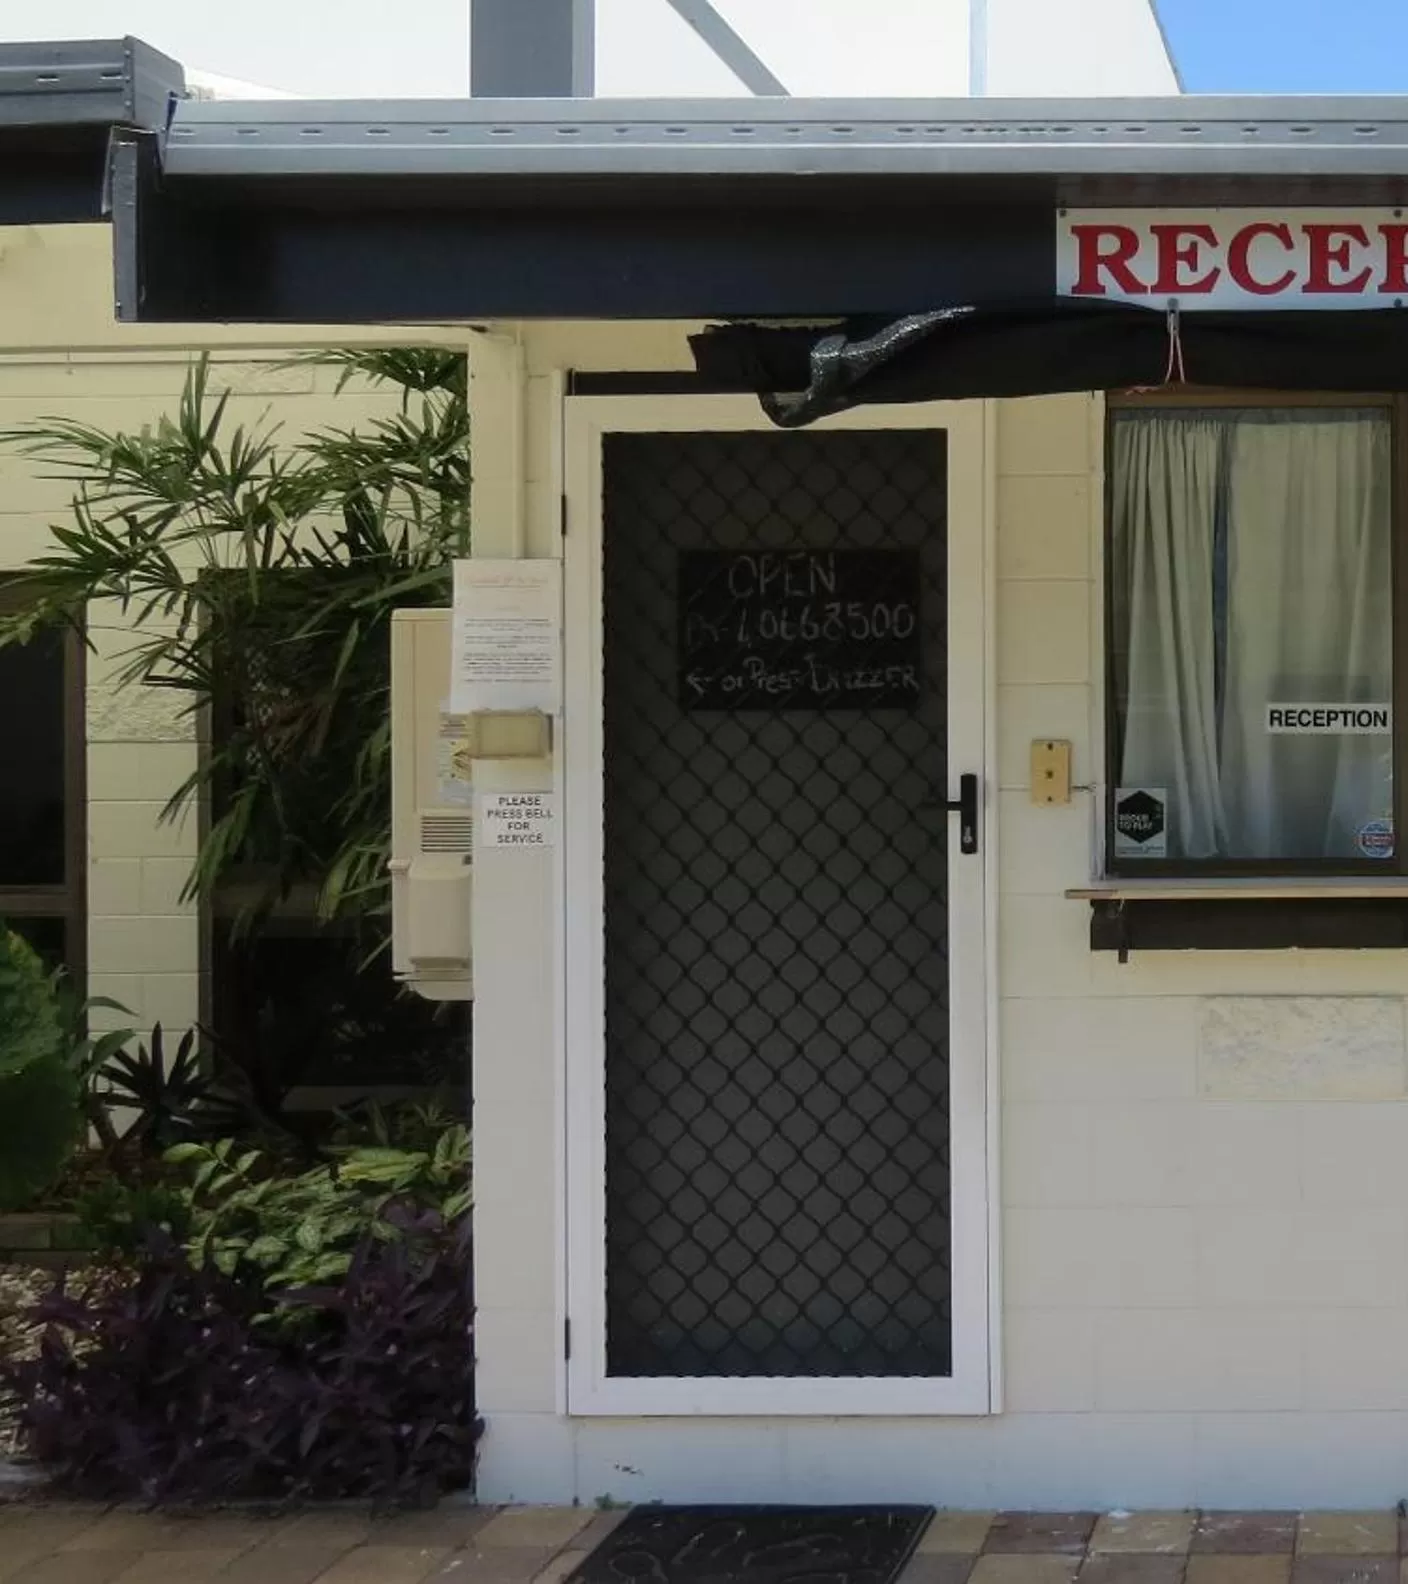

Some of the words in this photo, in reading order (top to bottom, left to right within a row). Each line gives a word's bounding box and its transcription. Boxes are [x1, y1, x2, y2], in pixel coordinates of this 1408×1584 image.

[728, 552, 836, 598] OPEN
[1269, 709, 1388, 728] RECEPTION
[498, 796, 541, 806] PLEASE
[487, 809, 523, 819] PRESS
[525, 809, 554, 819] BELL
[507, 821, 530, 831] FOR
[497, 834, 544, 844] SERVICE
